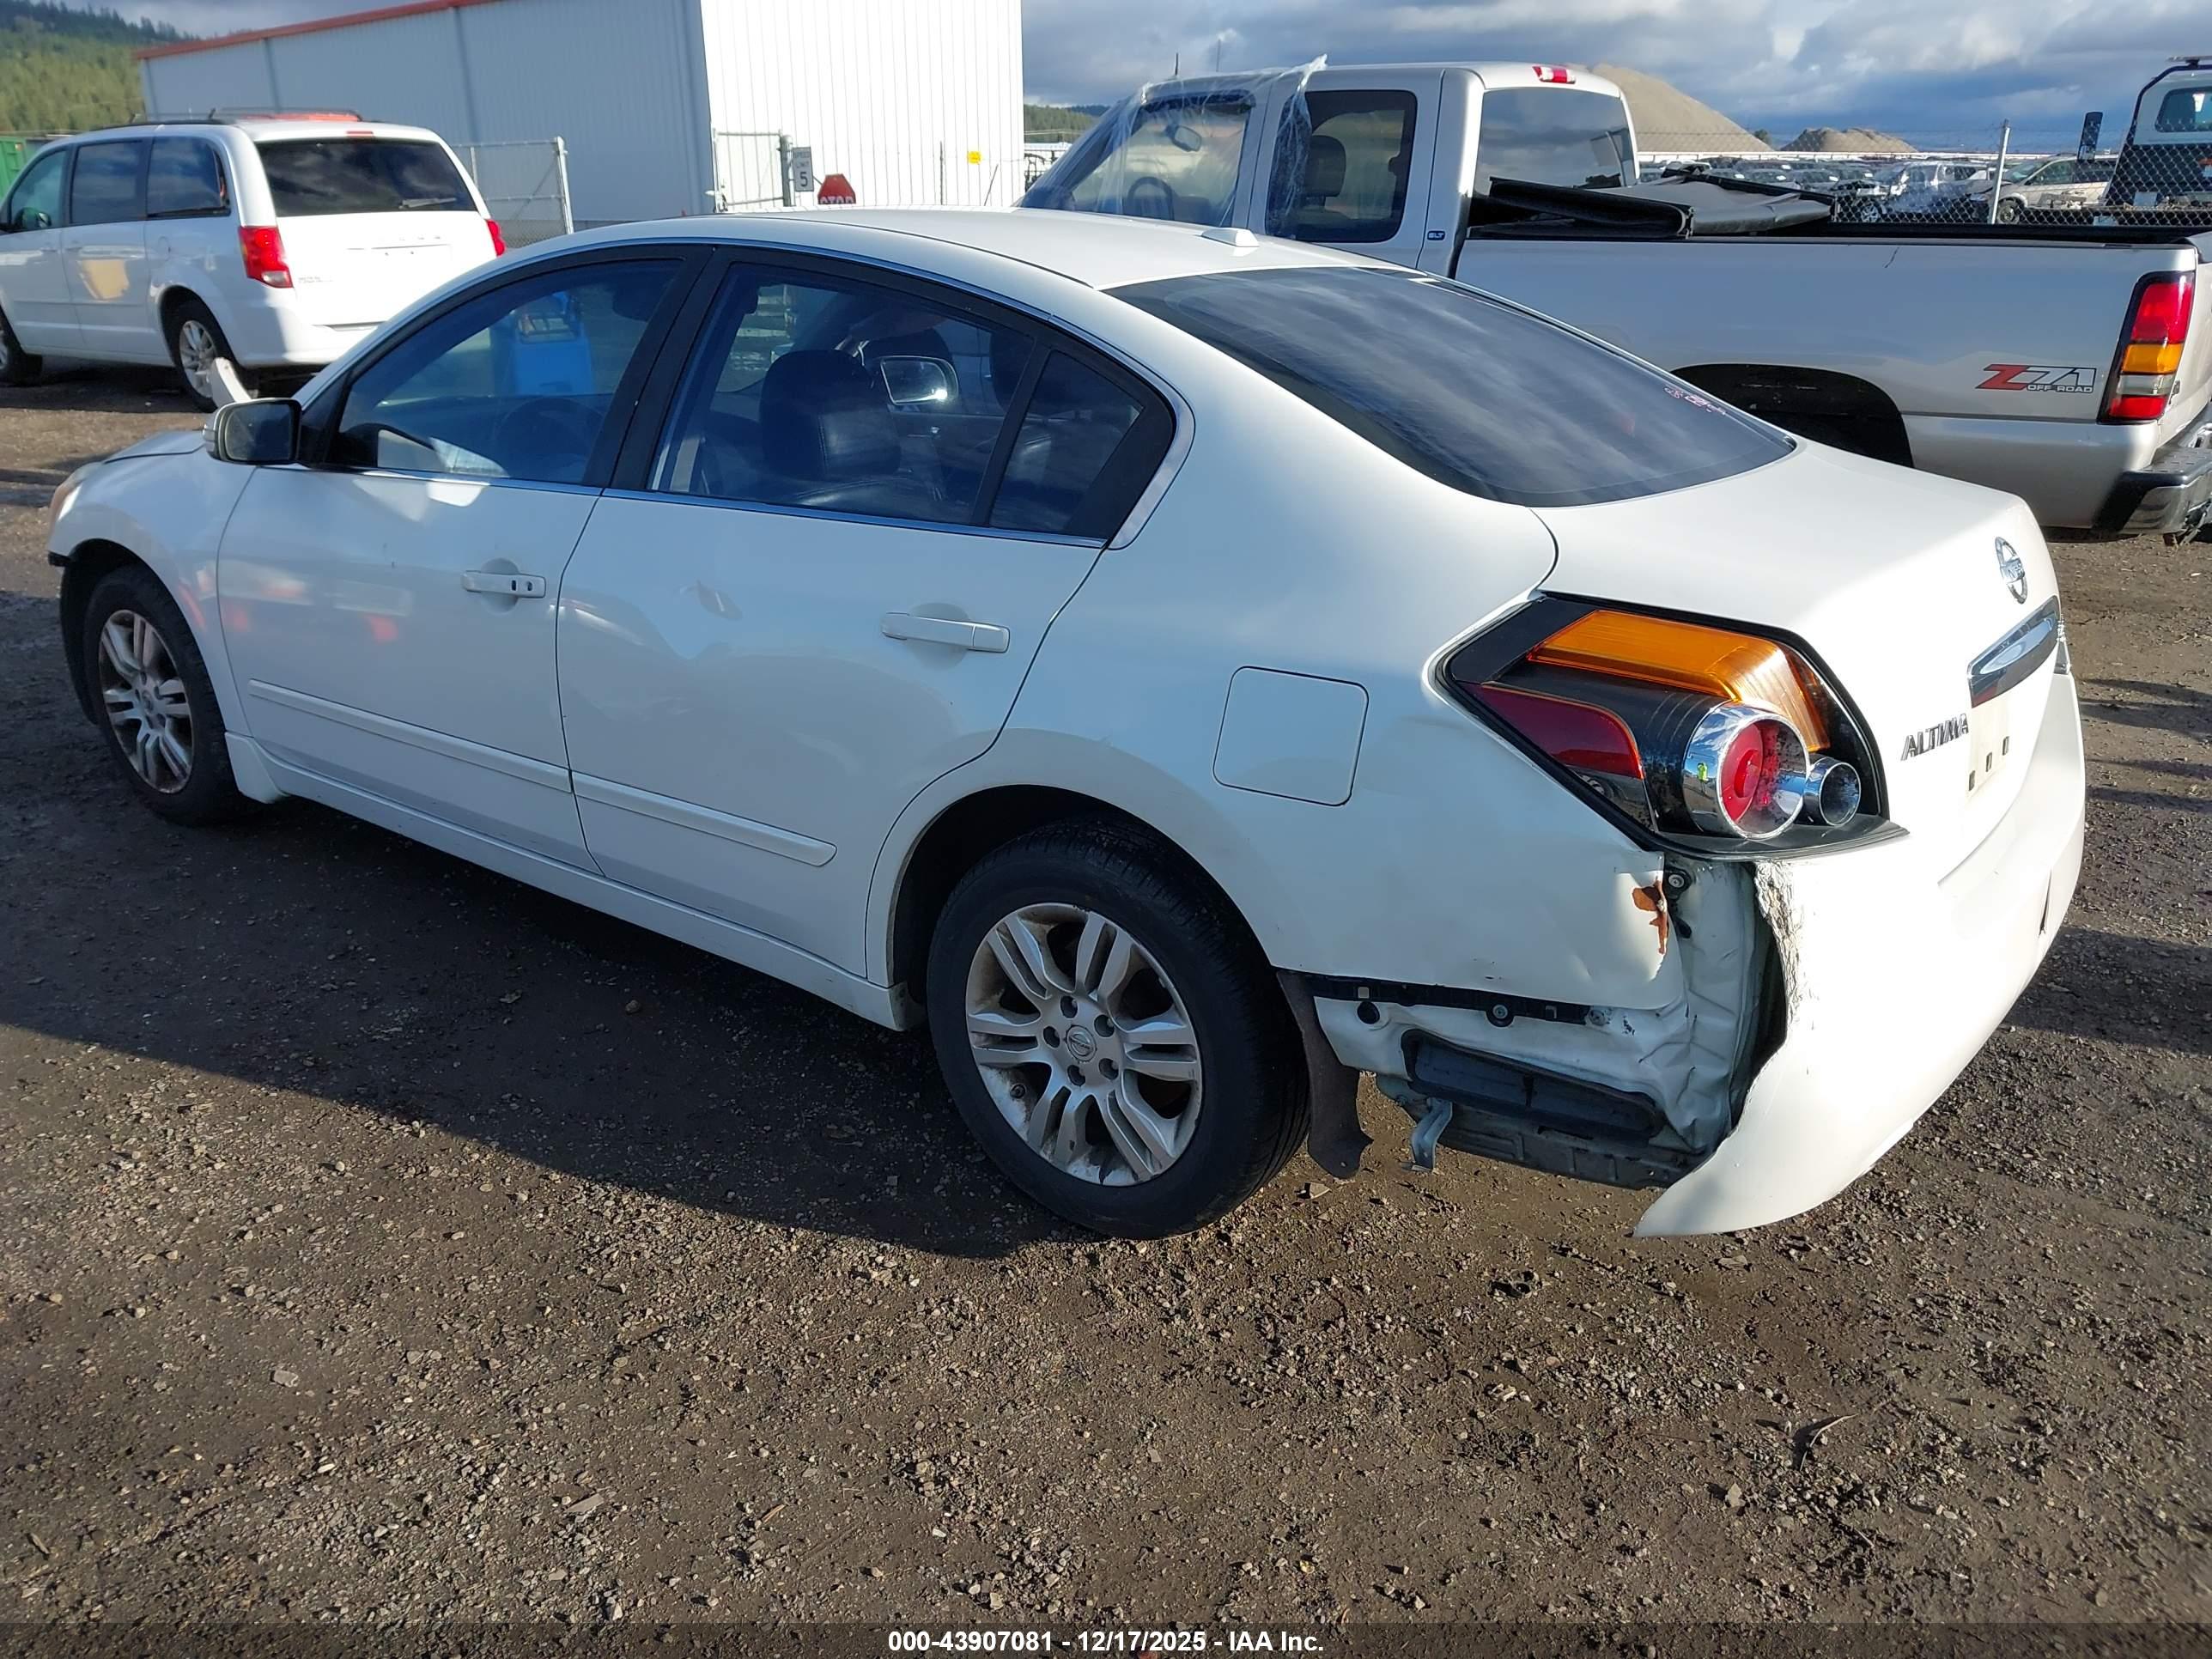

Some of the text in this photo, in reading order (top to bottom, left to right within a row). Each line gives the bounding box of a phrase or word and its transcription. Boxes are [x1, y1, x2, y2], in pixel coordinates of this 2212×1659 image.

[799, 171, 809, 187] 5
[1975, 363, 2097, 391] Z71
[1900, 713, 1969, 762] ALTIMA
